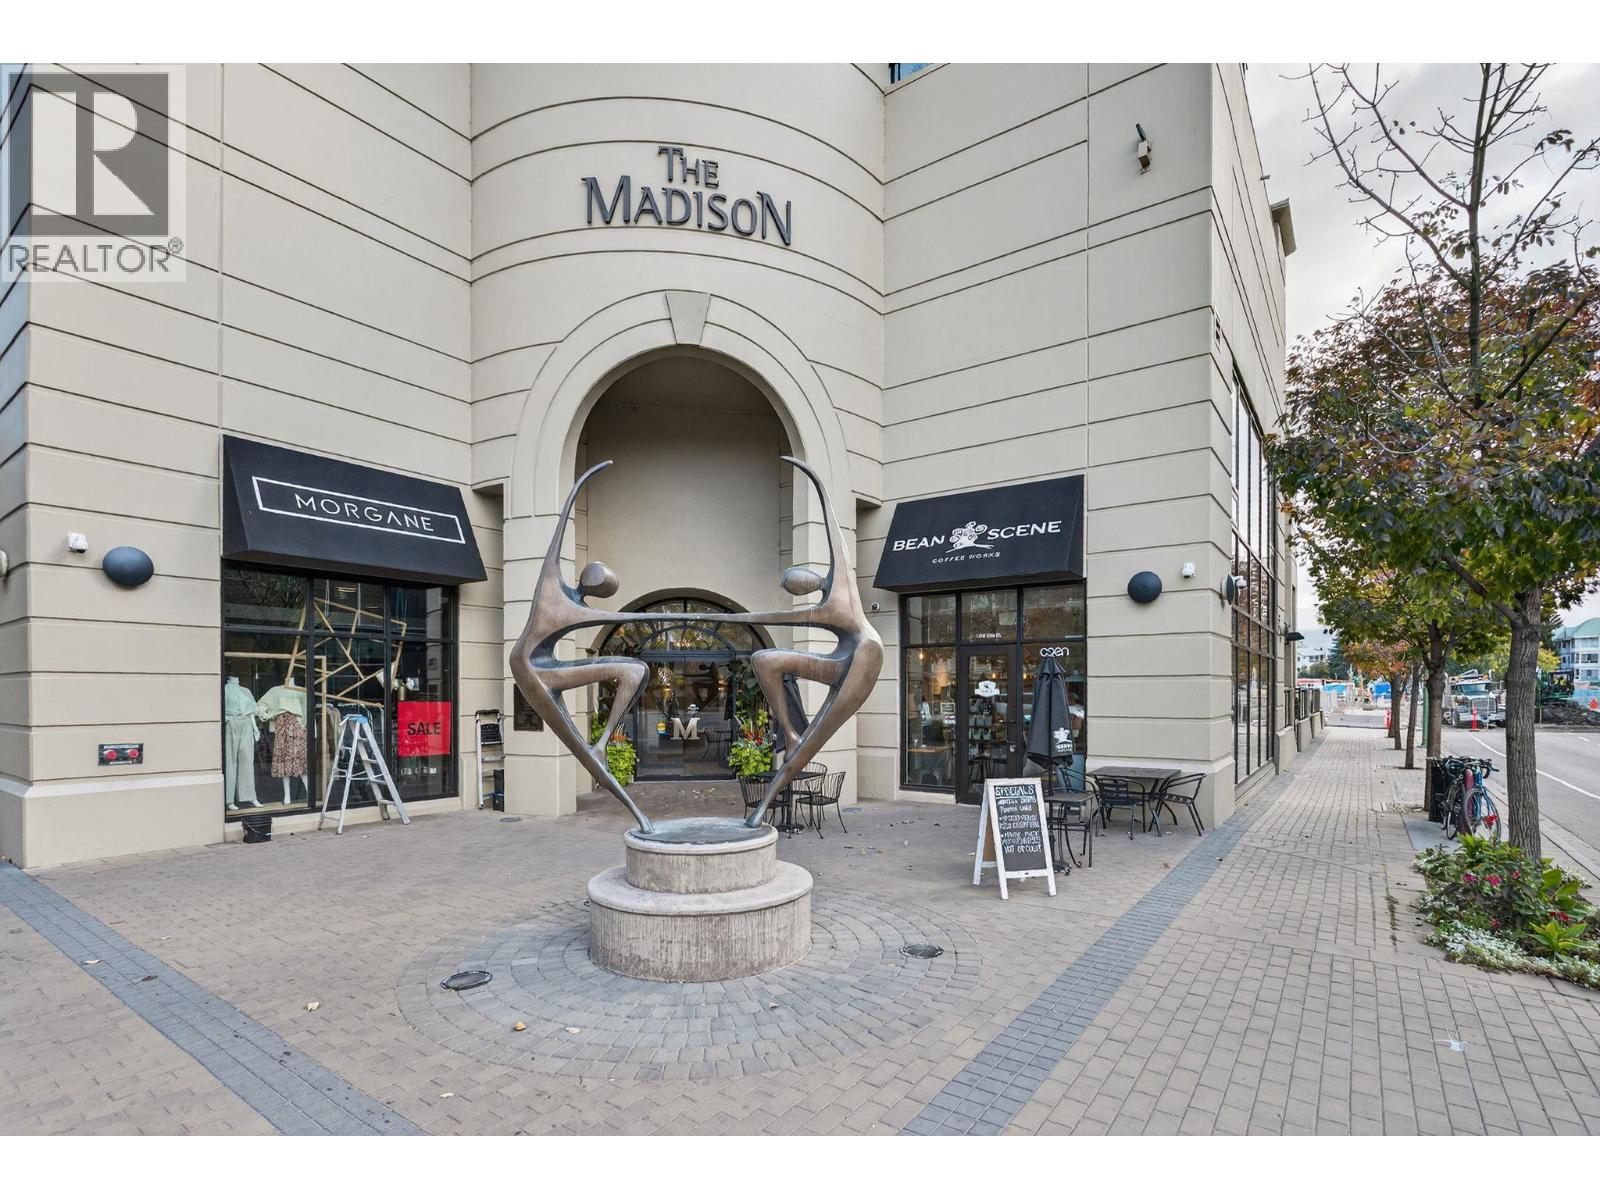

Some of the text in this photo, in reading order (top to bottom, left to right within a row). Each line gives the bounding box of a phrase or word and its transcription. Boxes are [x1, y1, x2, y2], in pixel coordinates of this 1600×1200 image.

[294, 493, 435, 533] MORGANE
[892, 520, 1062, 552] BEAN SCENE
[931, 551, 1001, 564] COFFEE WORKS
[407, 721, 441, 736] SALE
[670, 717, 701, 740] M
[995, 785, 1035, 796] SPECIALS
